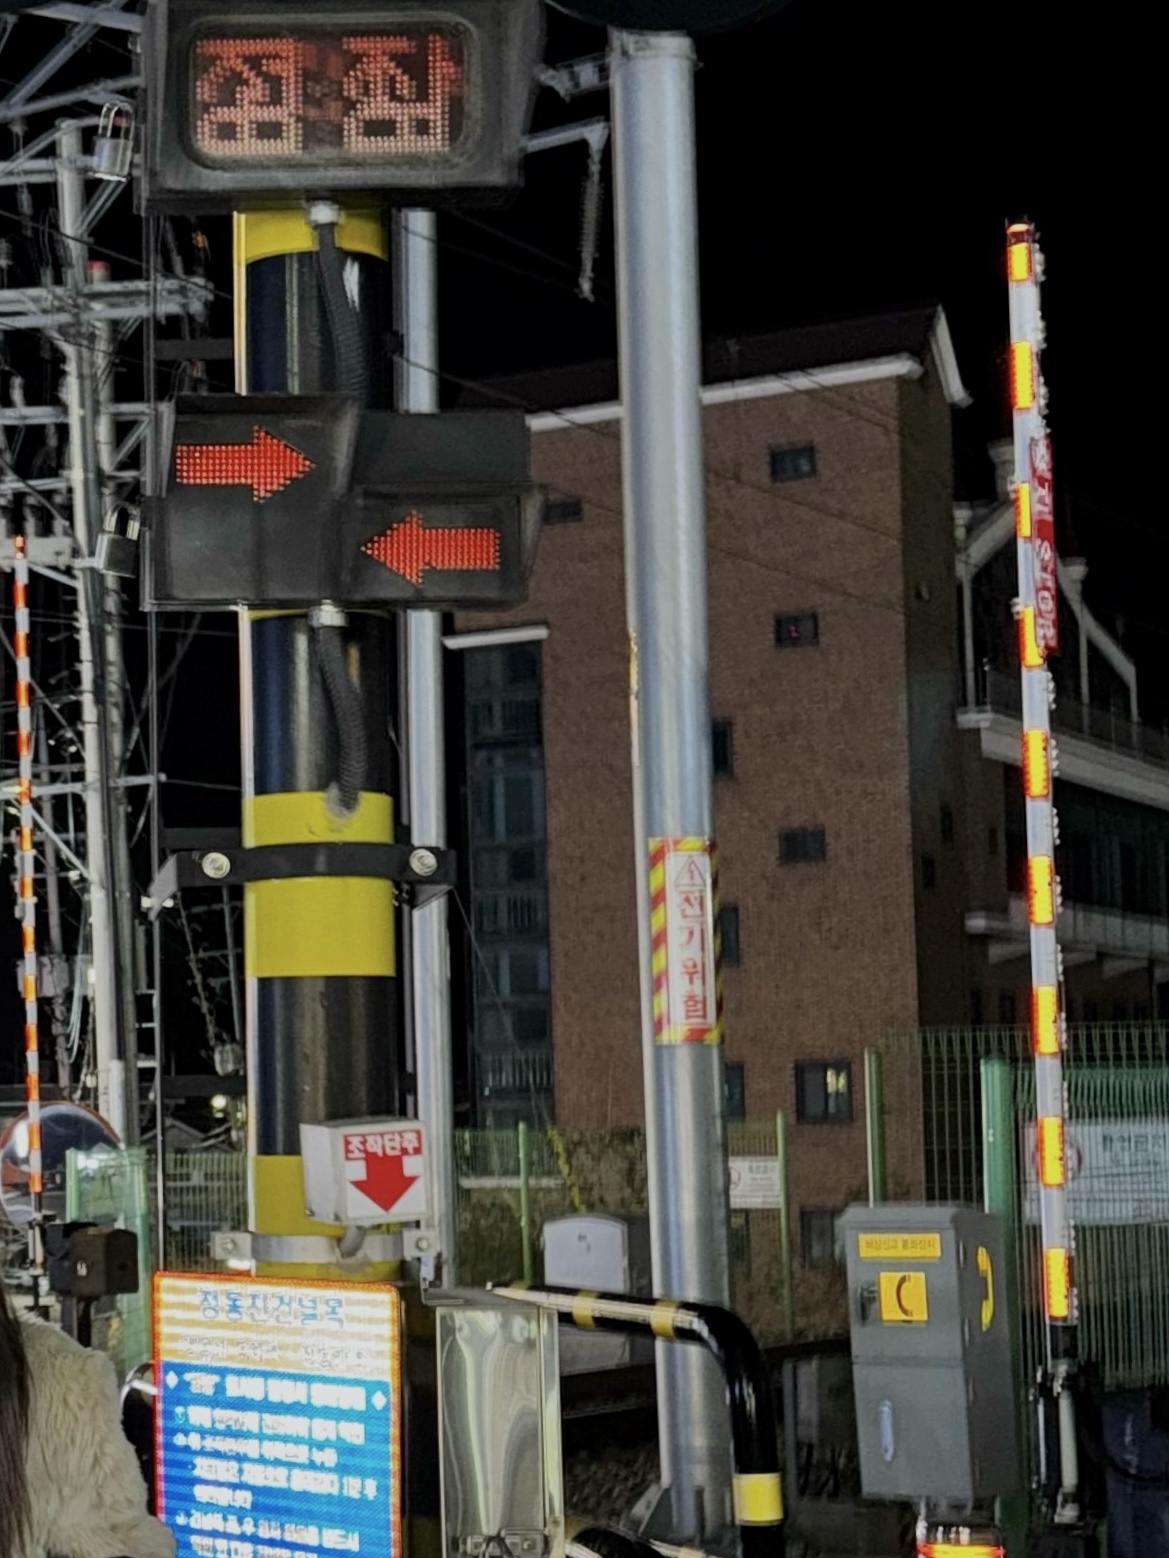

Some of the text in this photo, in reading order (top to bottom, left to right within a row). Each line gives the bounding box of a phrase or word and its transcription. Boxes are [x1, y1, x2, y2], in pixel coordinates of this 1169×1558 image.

[679, 888, 708, 1021] 전기위험
[347, 1131, 420, 1159] 조작단추
[199, 1287, 346, 1328] 정동진건널목
